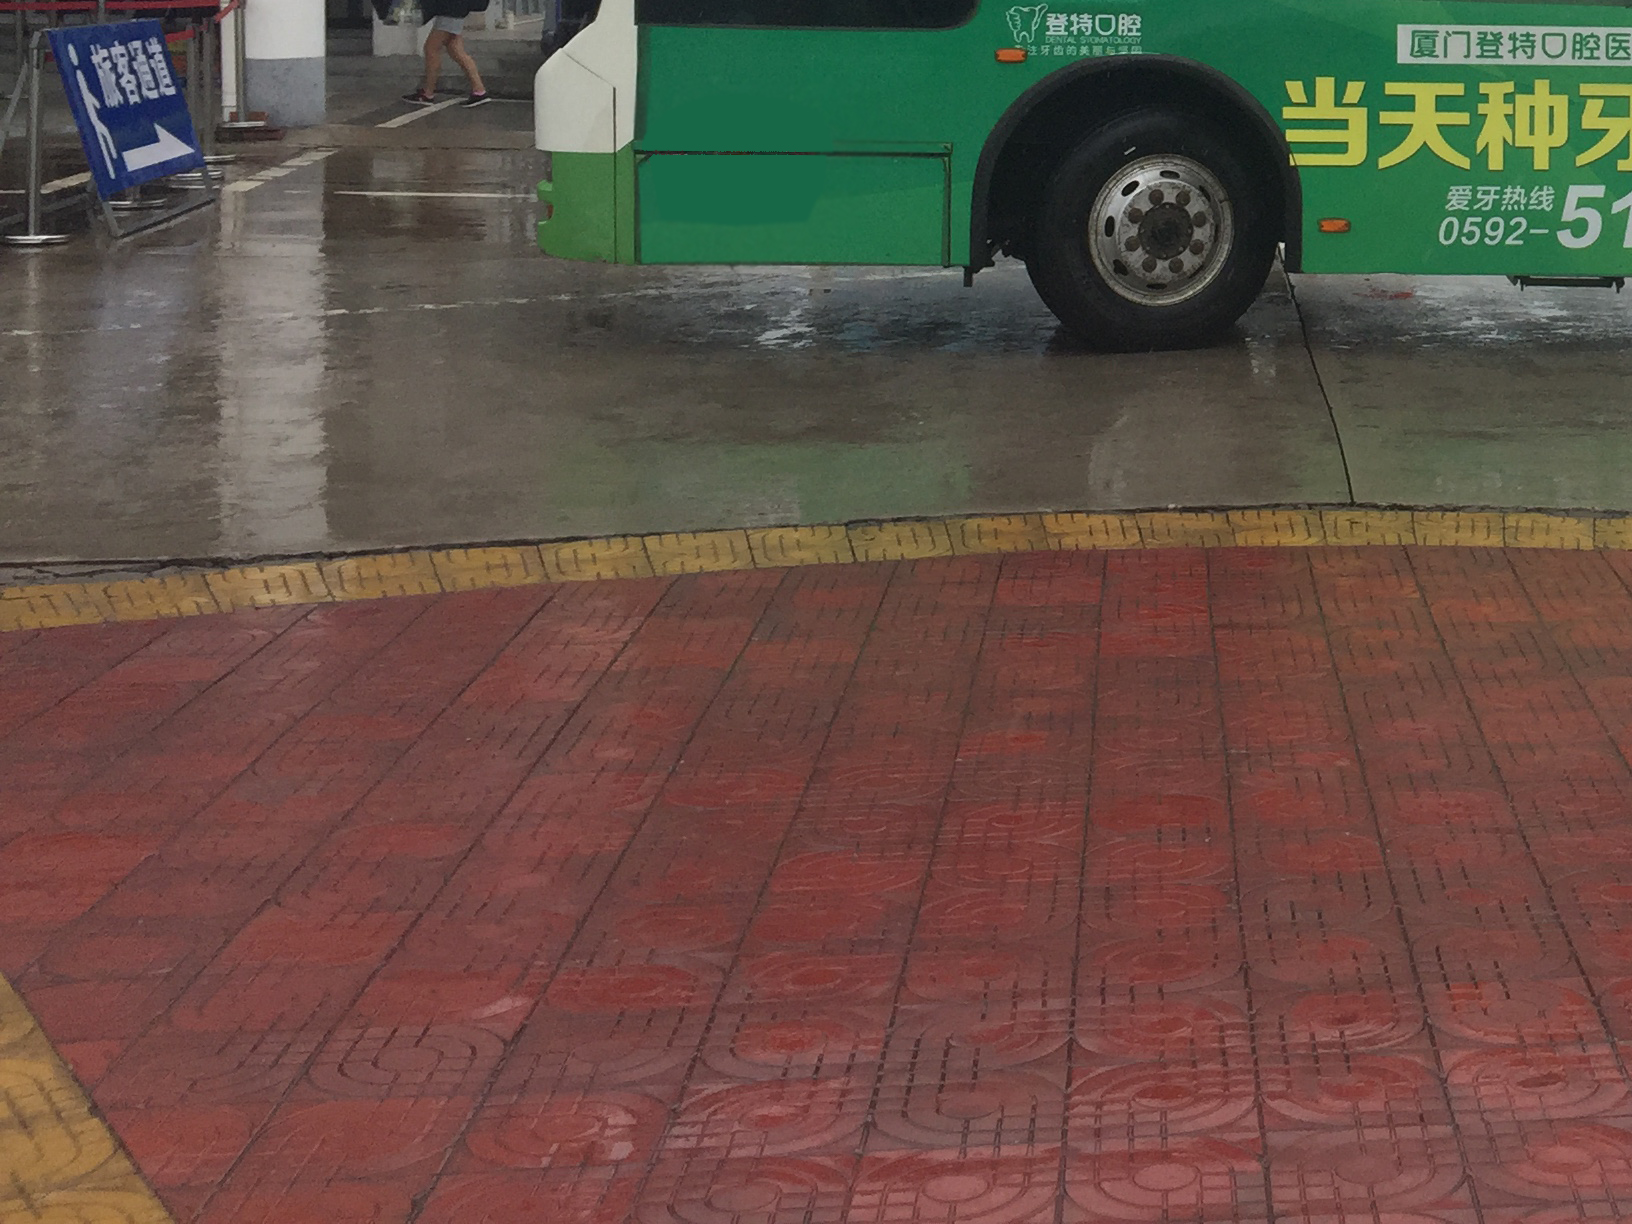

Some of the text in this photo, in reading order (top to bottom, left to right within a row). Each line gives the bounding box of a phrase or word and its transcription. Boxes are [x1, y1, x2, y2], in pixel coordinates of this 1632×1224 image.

[1045, 13, 1142, 36] 登特口腔
[1045, 36, 1077, 44] DENTAL
[90, 37, 176, 108] 旅客通道
[1445, 185, 1555, 212] 爱牙热线
